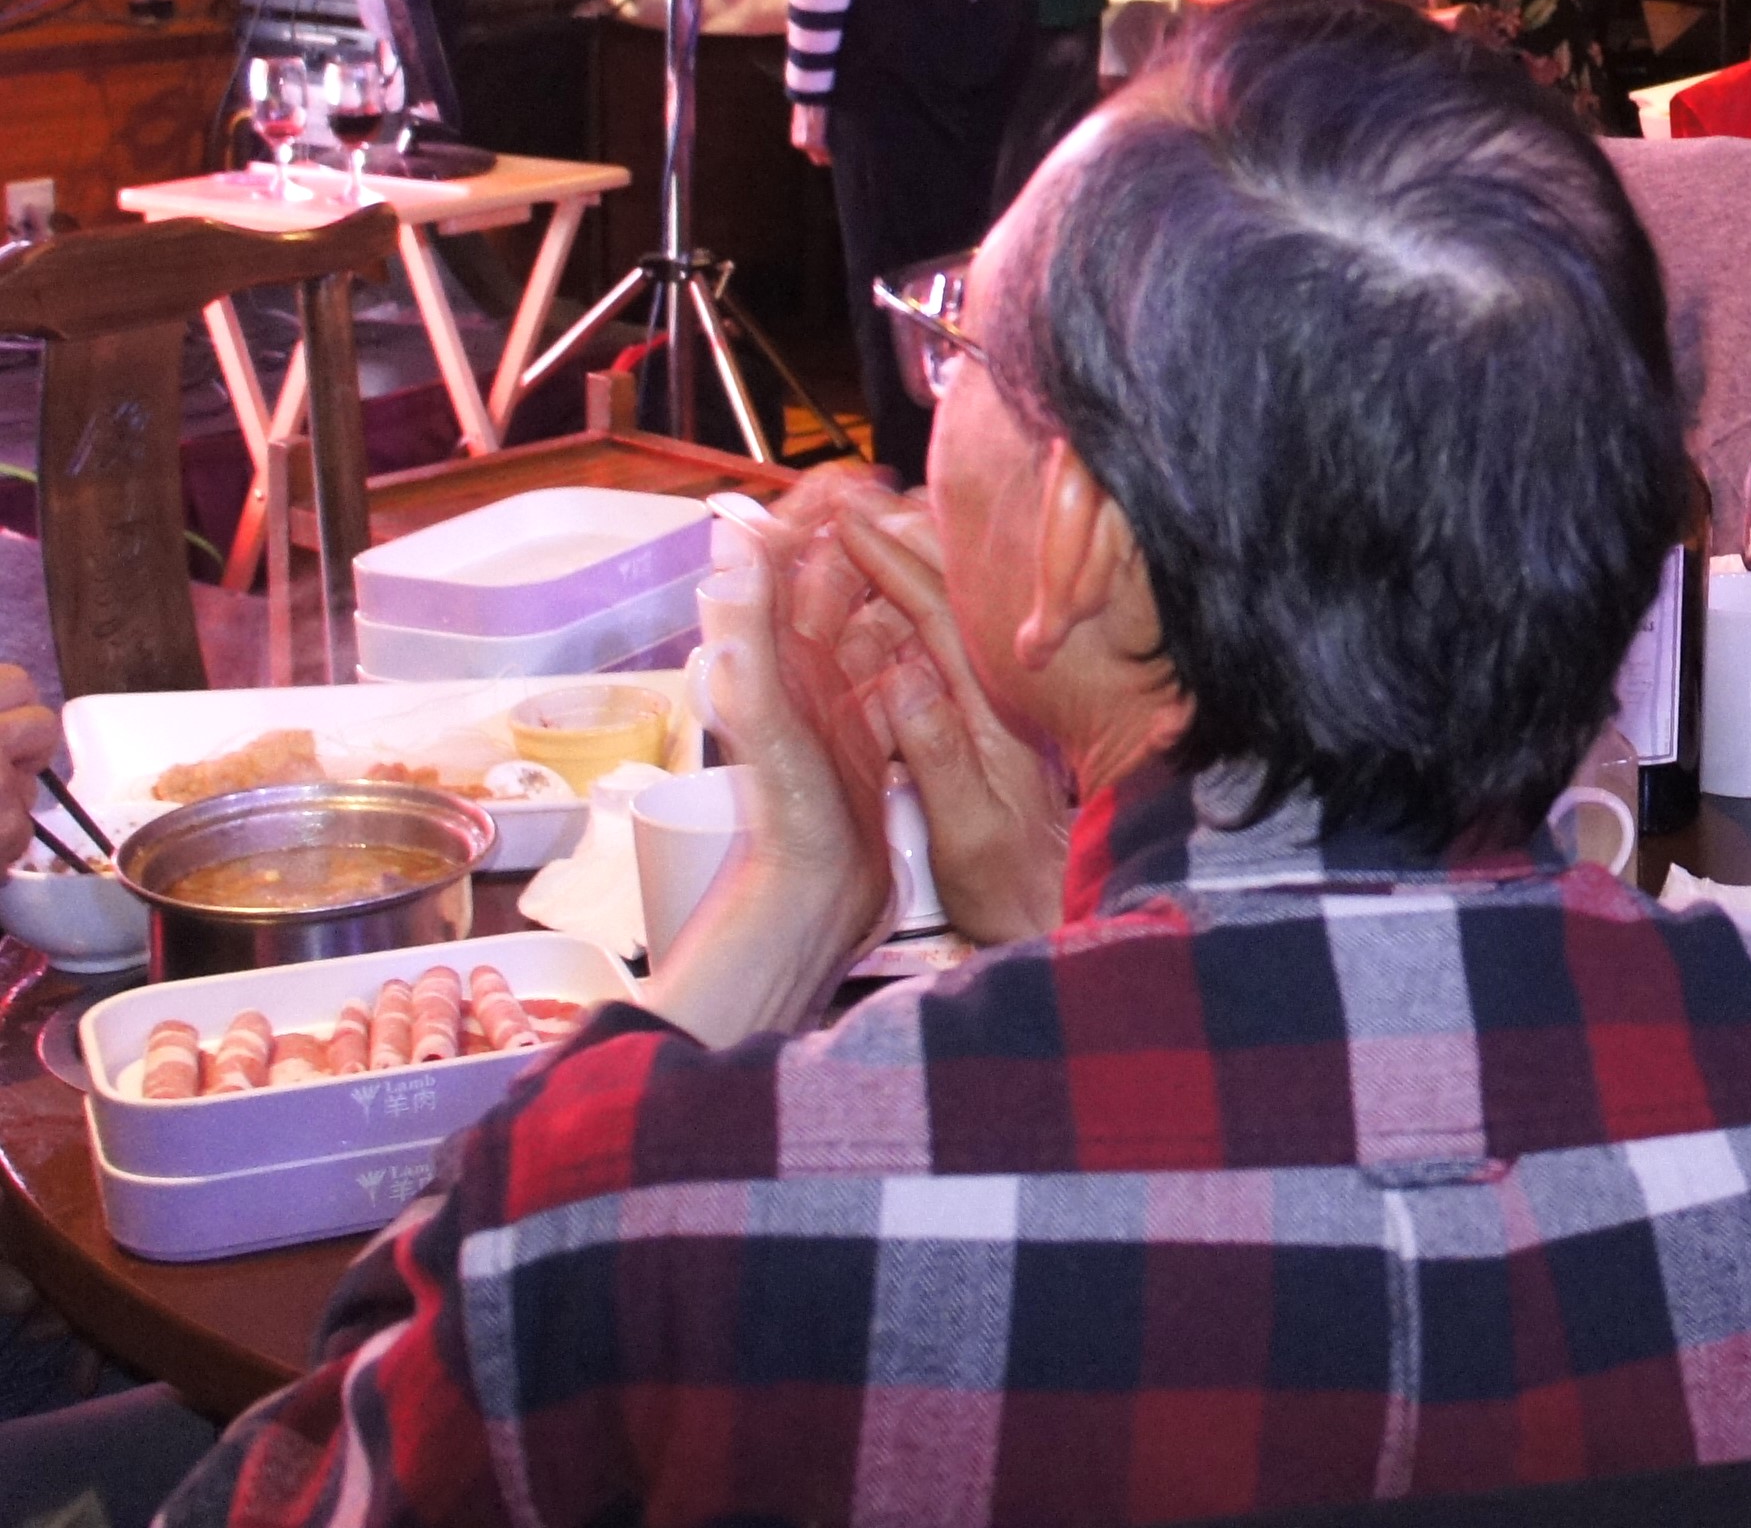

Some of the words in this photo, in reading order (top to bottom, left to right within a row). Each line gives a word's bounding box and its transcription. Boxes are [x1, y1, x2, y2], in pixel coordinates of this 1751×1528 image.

[384, 1074, 436, 1092] Lamb
[384, 1089, 437, 1117] 羊肉
[391, 1162, 432, 1179] Lam
